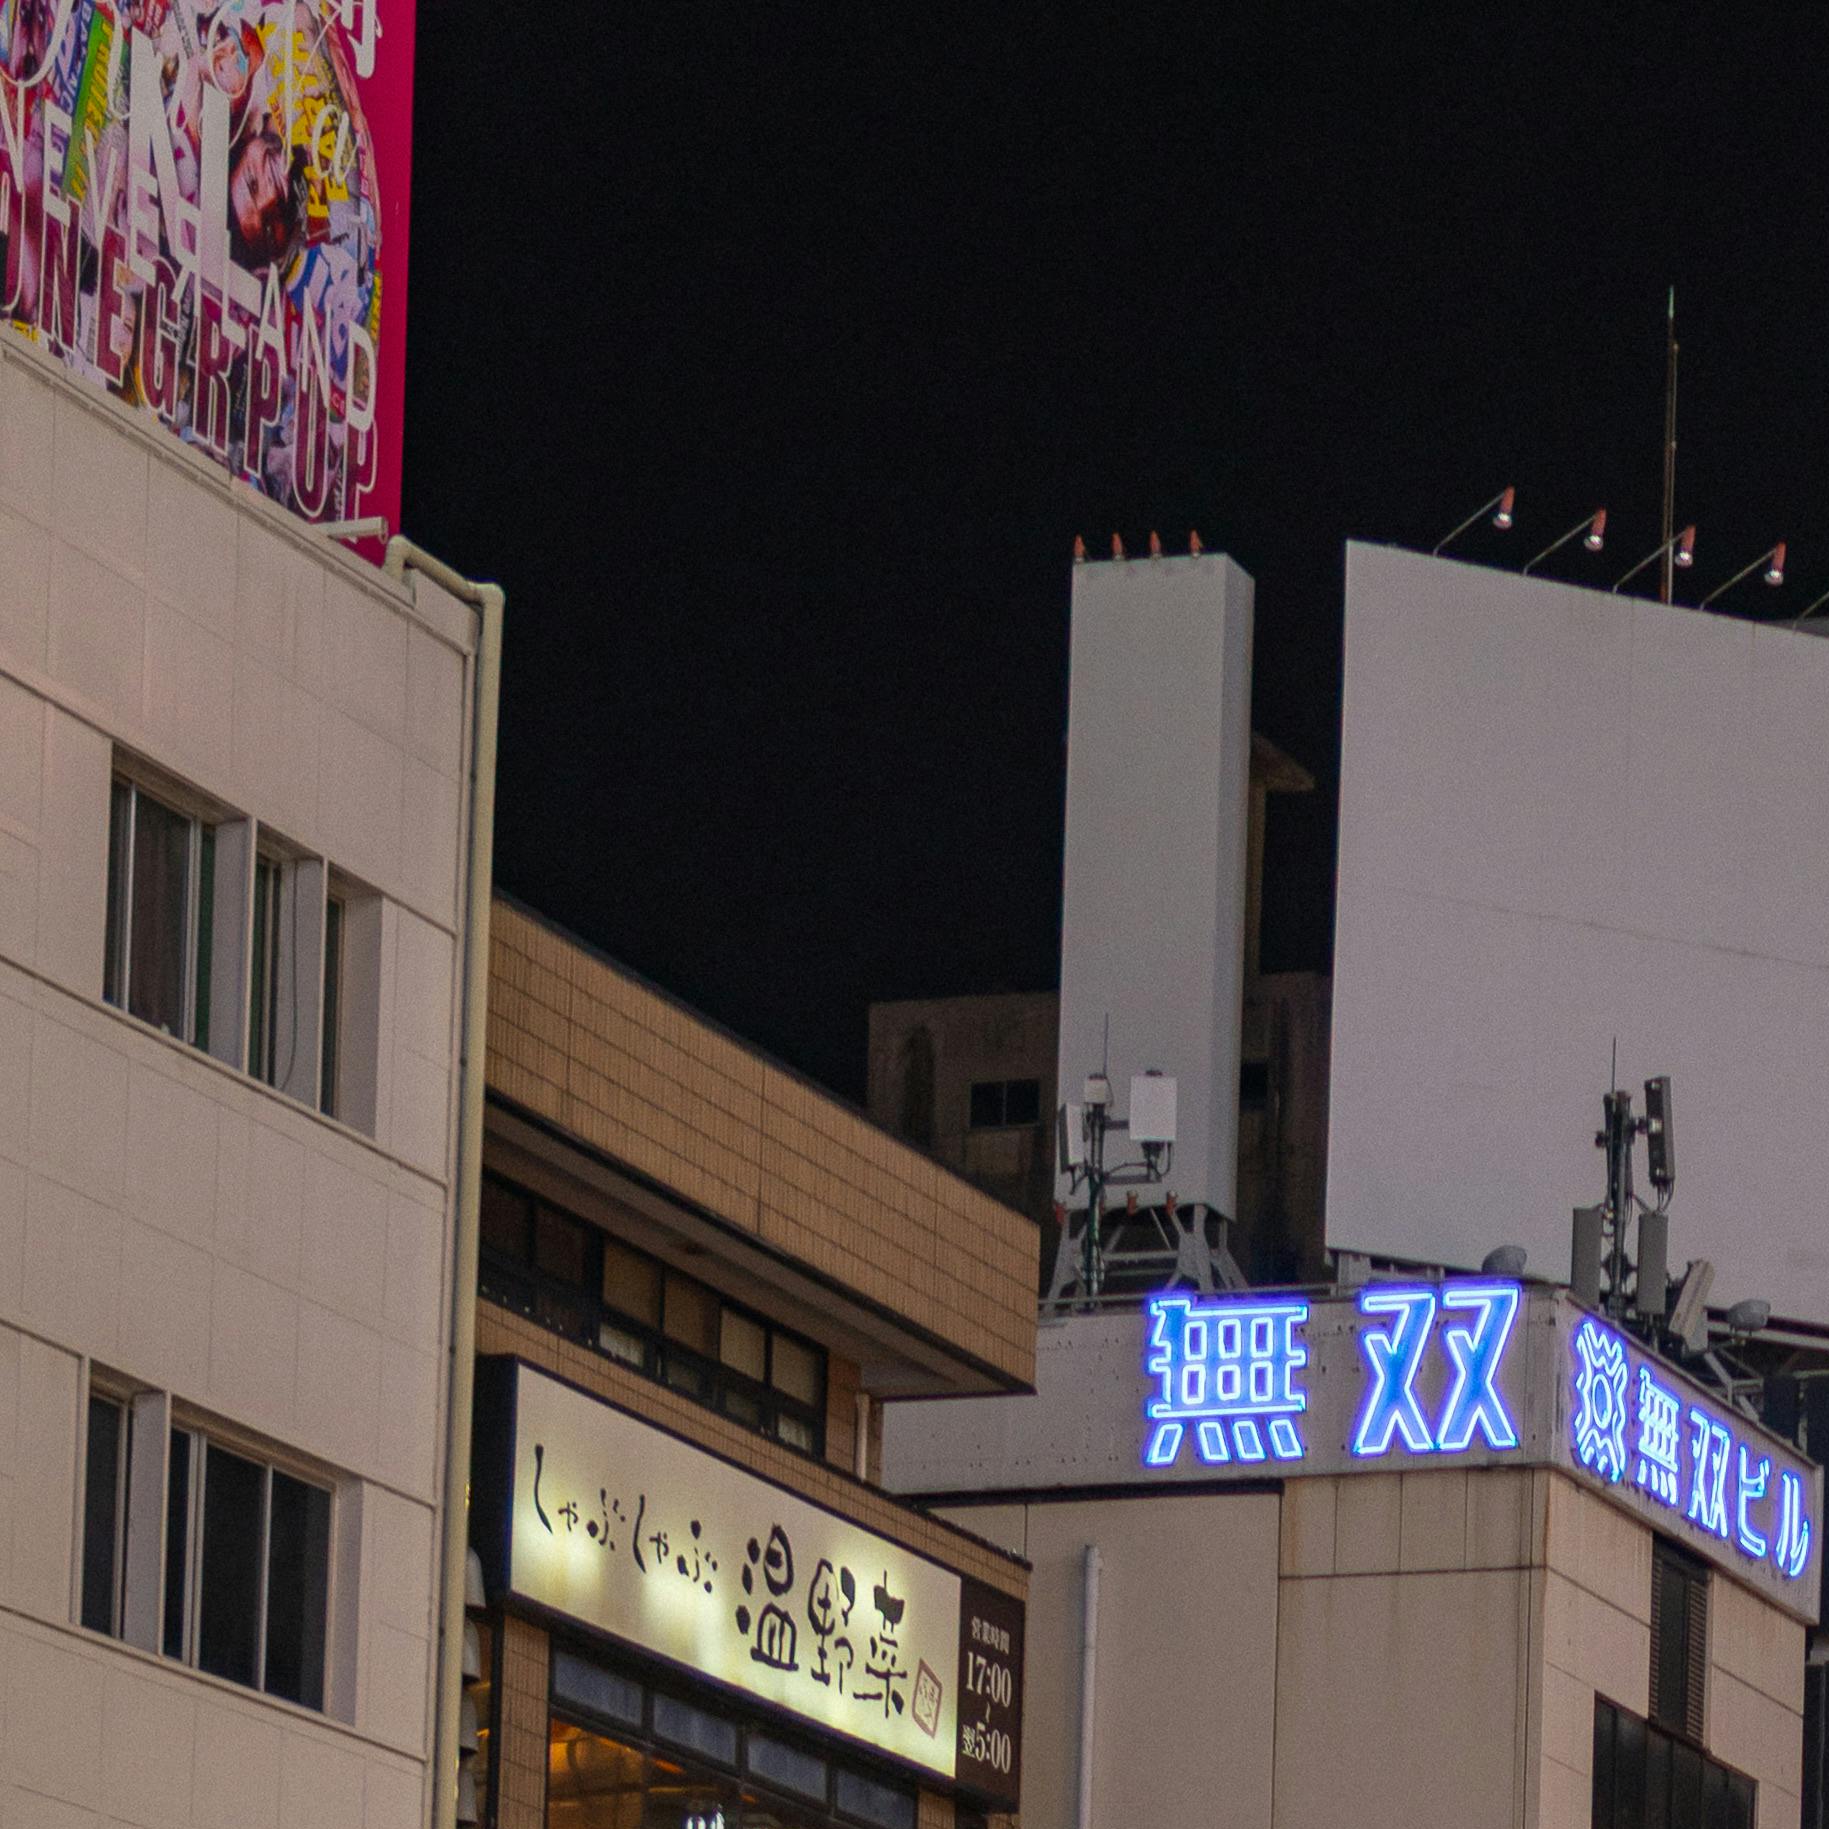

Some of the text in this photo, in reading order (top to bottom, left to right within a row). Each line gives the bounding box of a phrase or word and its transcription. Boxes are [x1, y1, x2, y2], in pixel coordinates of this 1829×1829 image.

[1146, 1284, 1520, 1467] 無双
[1638, 1365, 1811, 1576] 無双ビル
[535, 1443, 909, 1717] しゃぶしゃぶ 温野菜
[967, 1652, 1011, 1708] 17:00
